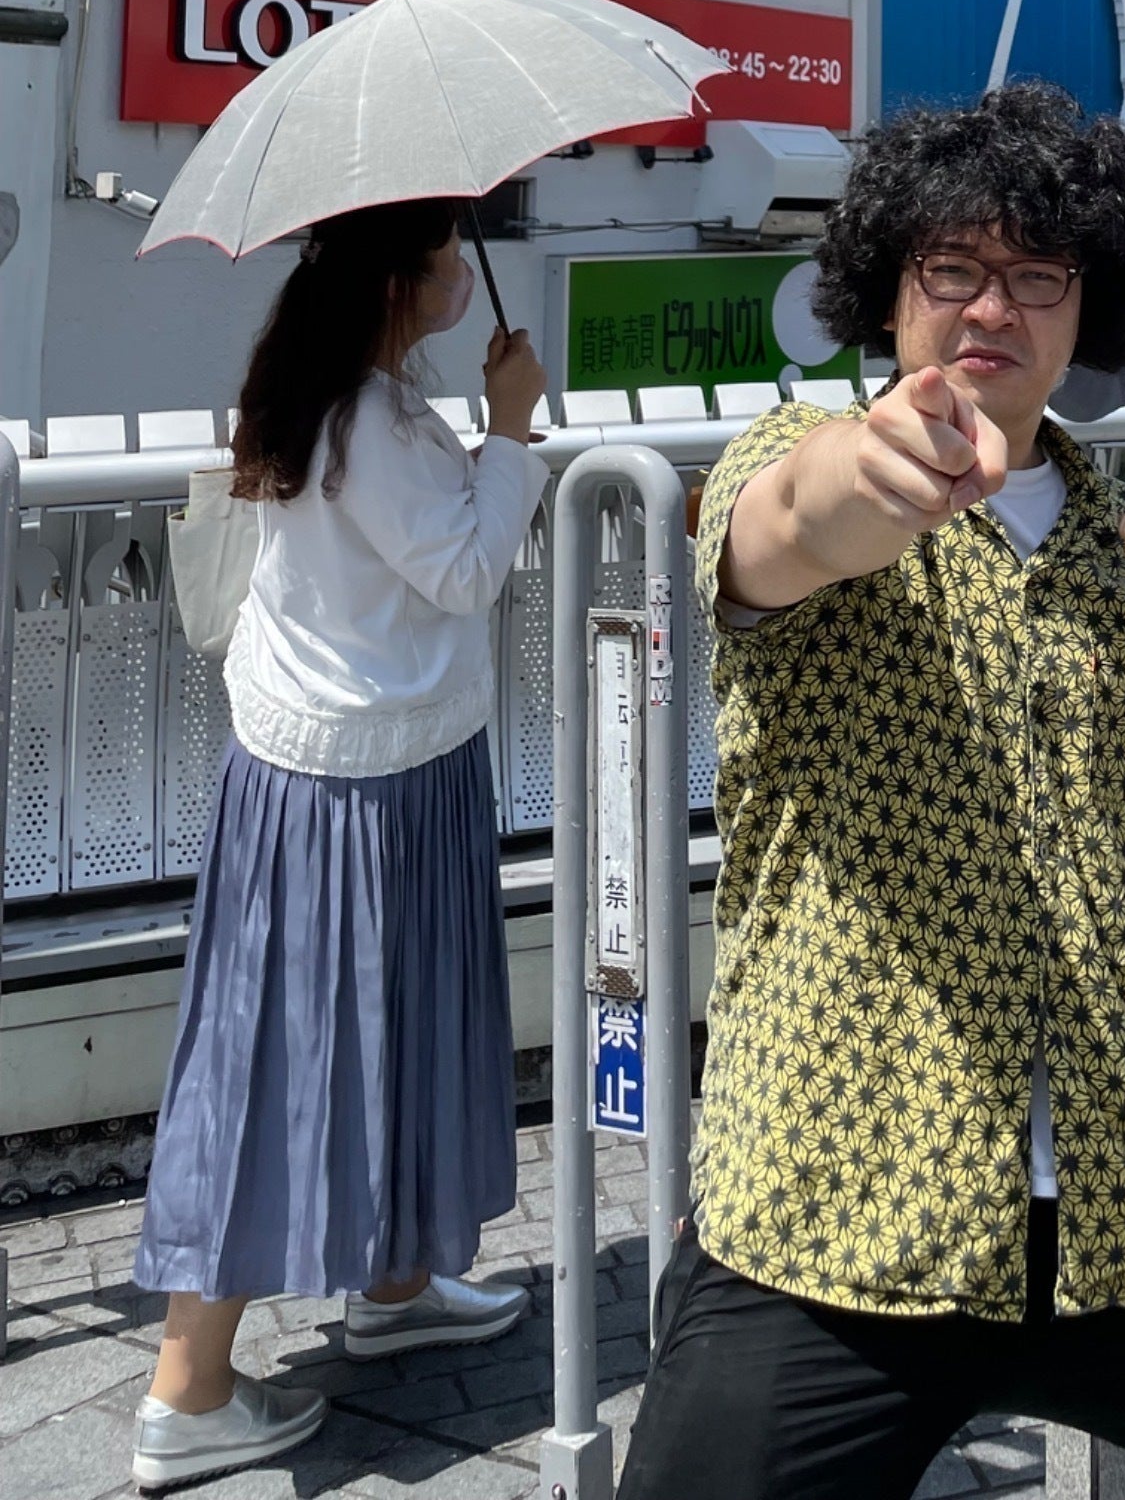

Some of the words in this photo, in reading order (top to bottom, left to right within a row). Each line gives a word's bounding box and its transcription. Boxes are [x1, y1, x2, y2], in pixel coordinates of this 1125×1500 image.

[663, 296, 766, 376] ピタットハウス
[604, 873, 629, 955] 禁止
[600, 1000, 639, 1125] 禁止
